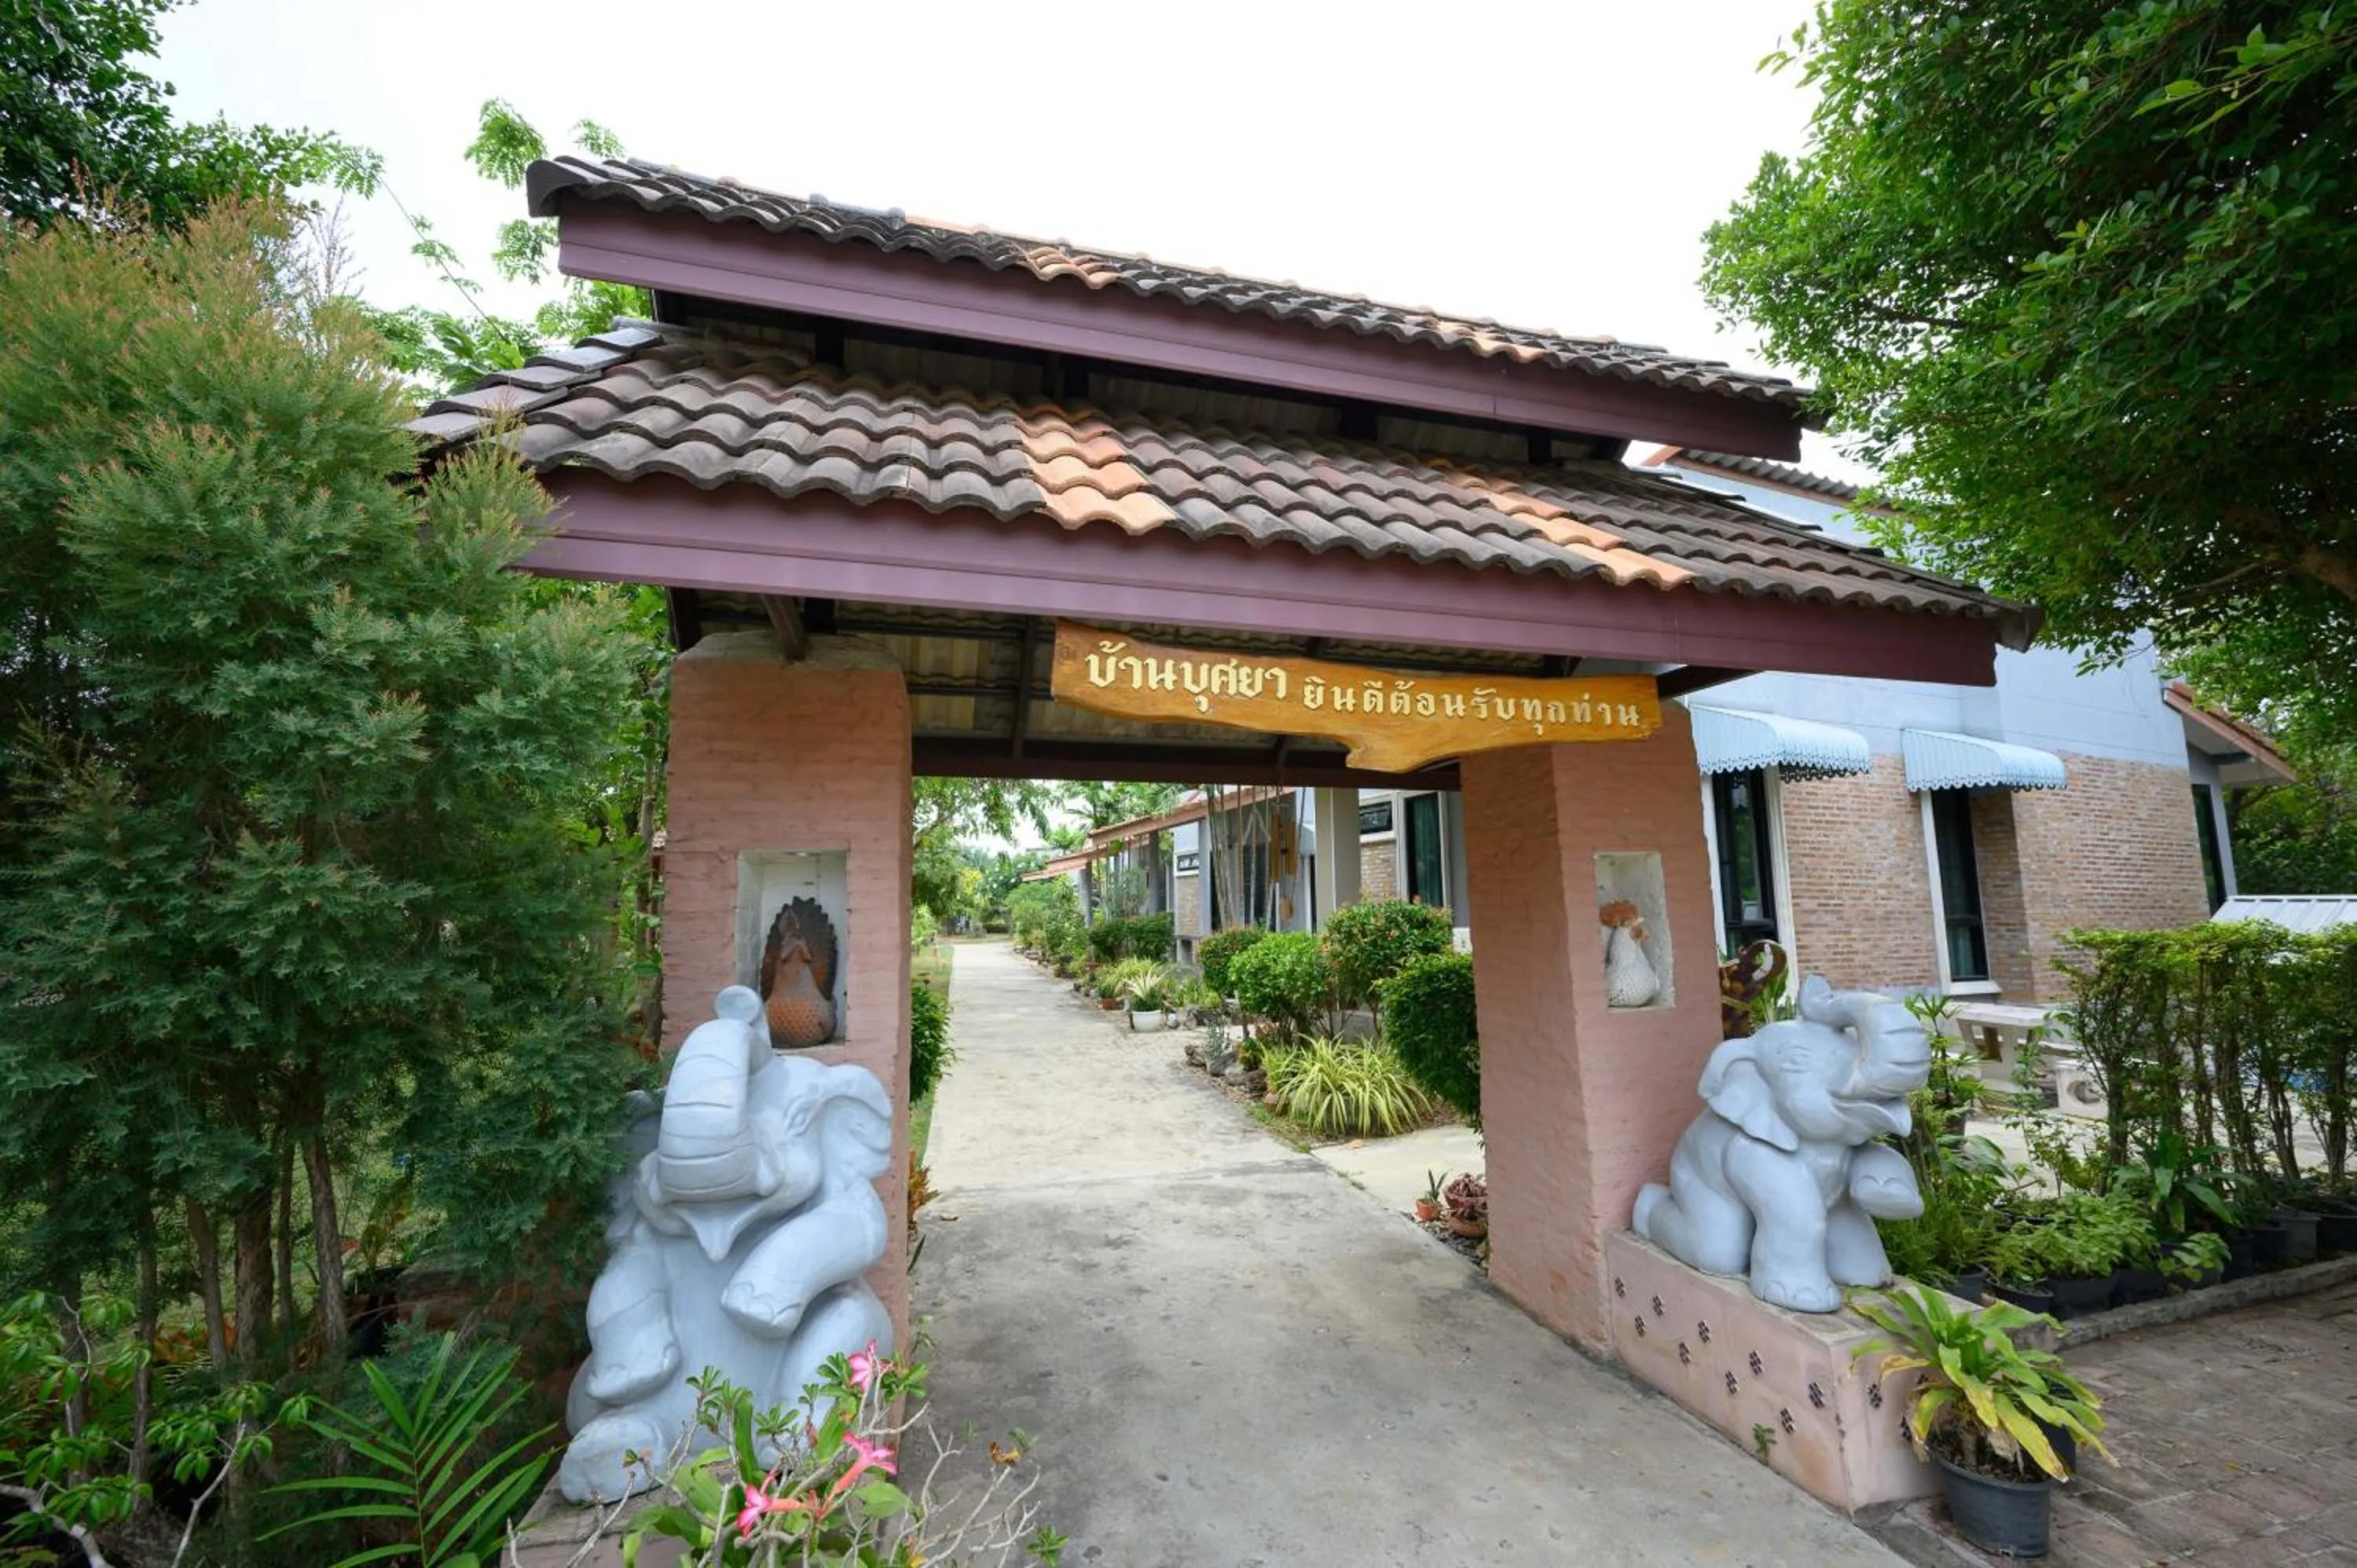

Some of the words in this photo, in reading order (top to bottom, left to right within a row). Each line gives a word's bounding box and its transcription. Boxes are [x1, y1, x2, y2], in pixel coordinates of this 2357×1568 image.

[1085, 640, 1287, 713] บ้านบุศยา
[1303, 676, 1640, 735] ยินดีต้อนรับทุกท่าน
